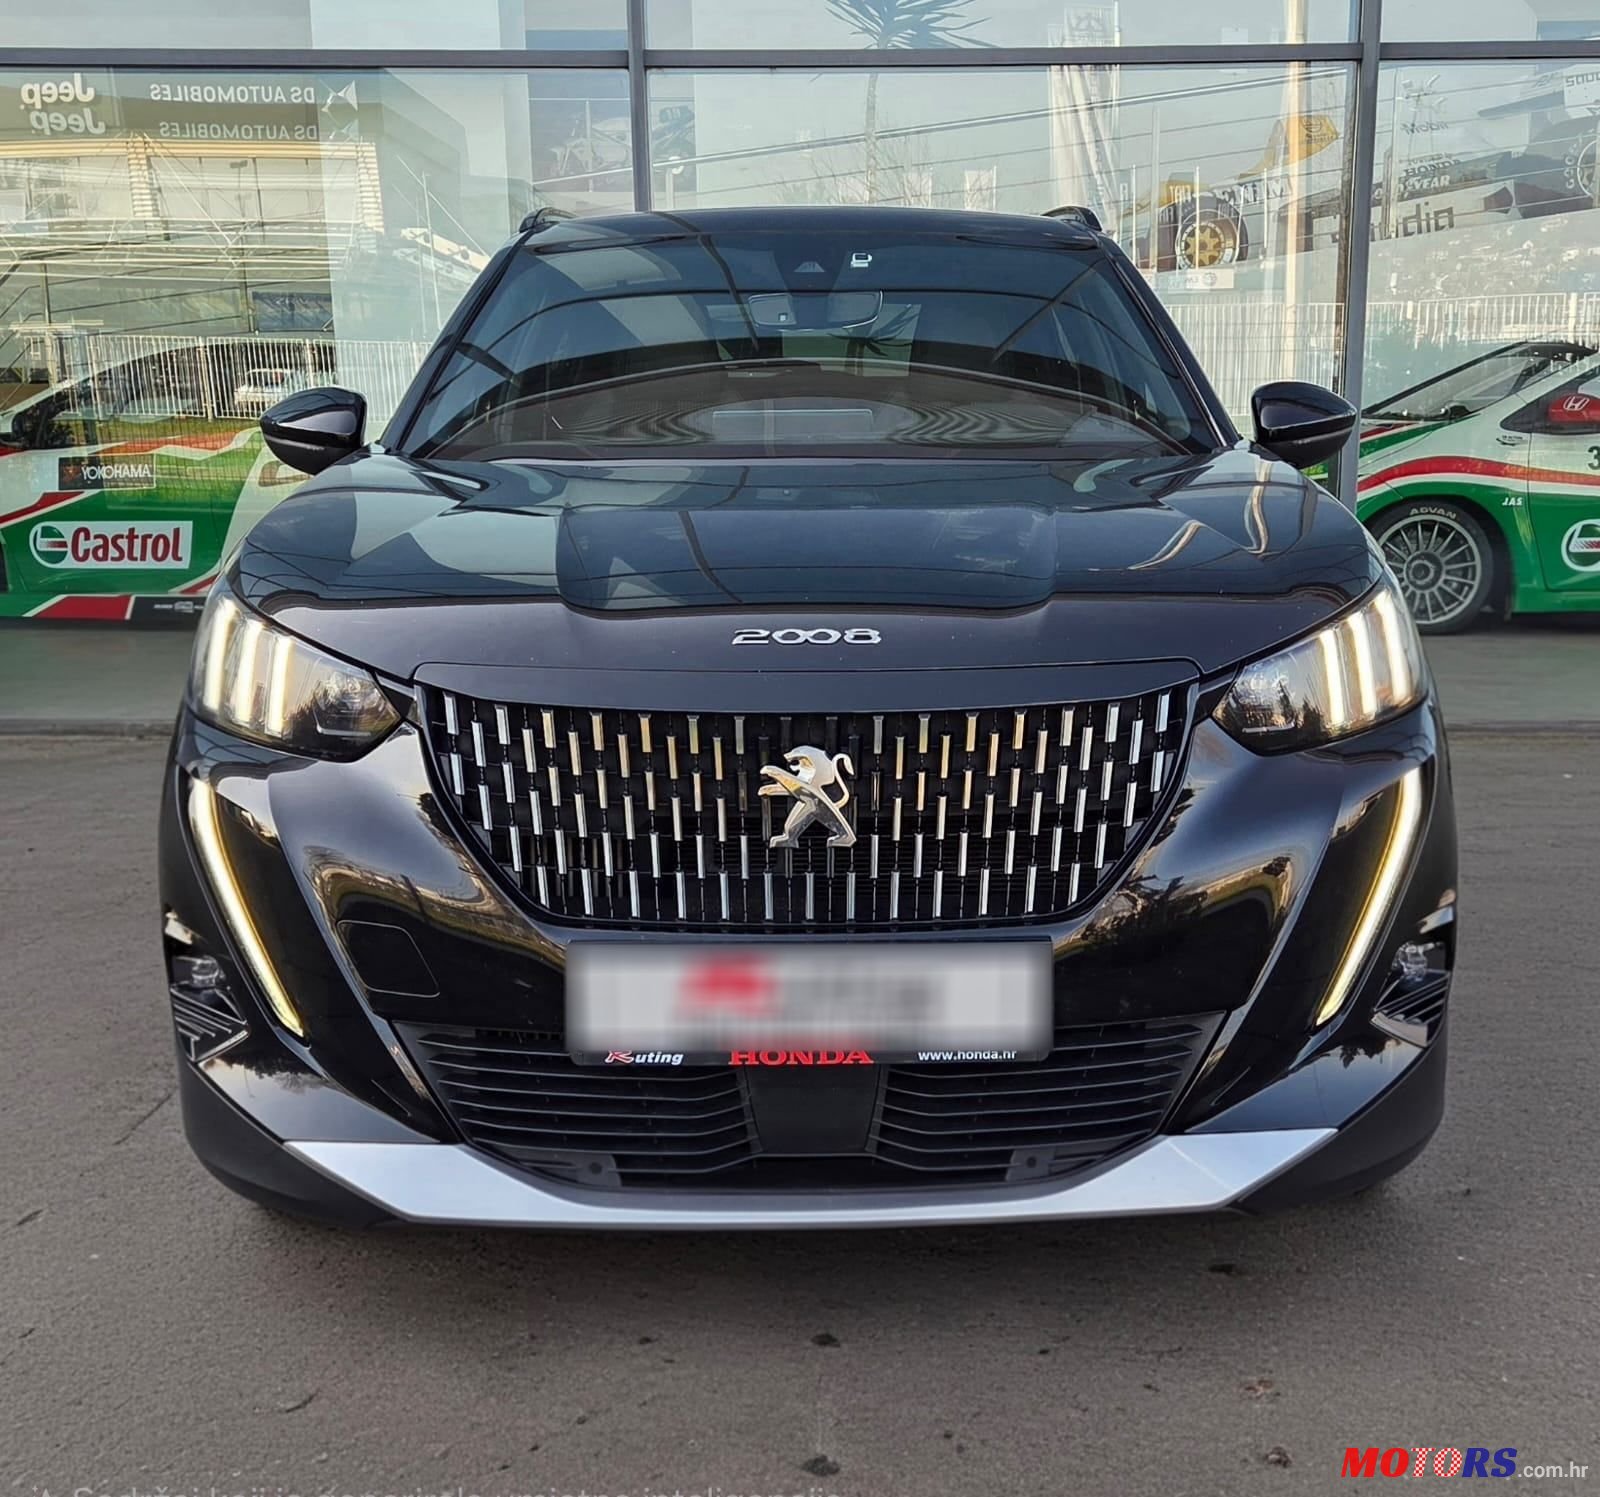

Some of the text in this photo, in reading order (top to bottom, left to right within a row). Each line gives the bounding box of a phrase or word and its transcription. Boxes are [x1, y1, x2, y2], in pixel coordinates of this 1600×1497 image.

[81, 464, 150, 480] YOKOHAMA
[1502, 497, 1523, 506] JAS
[1409, 506, 1457, 519] ADVAN
[71, 526, 183, 563] Castrol
[732, 628, 882, 645] 2008
[728, 1048, 875, 1066] HONDA
[918, 1050, 1017, 1061] www.honda.hr
